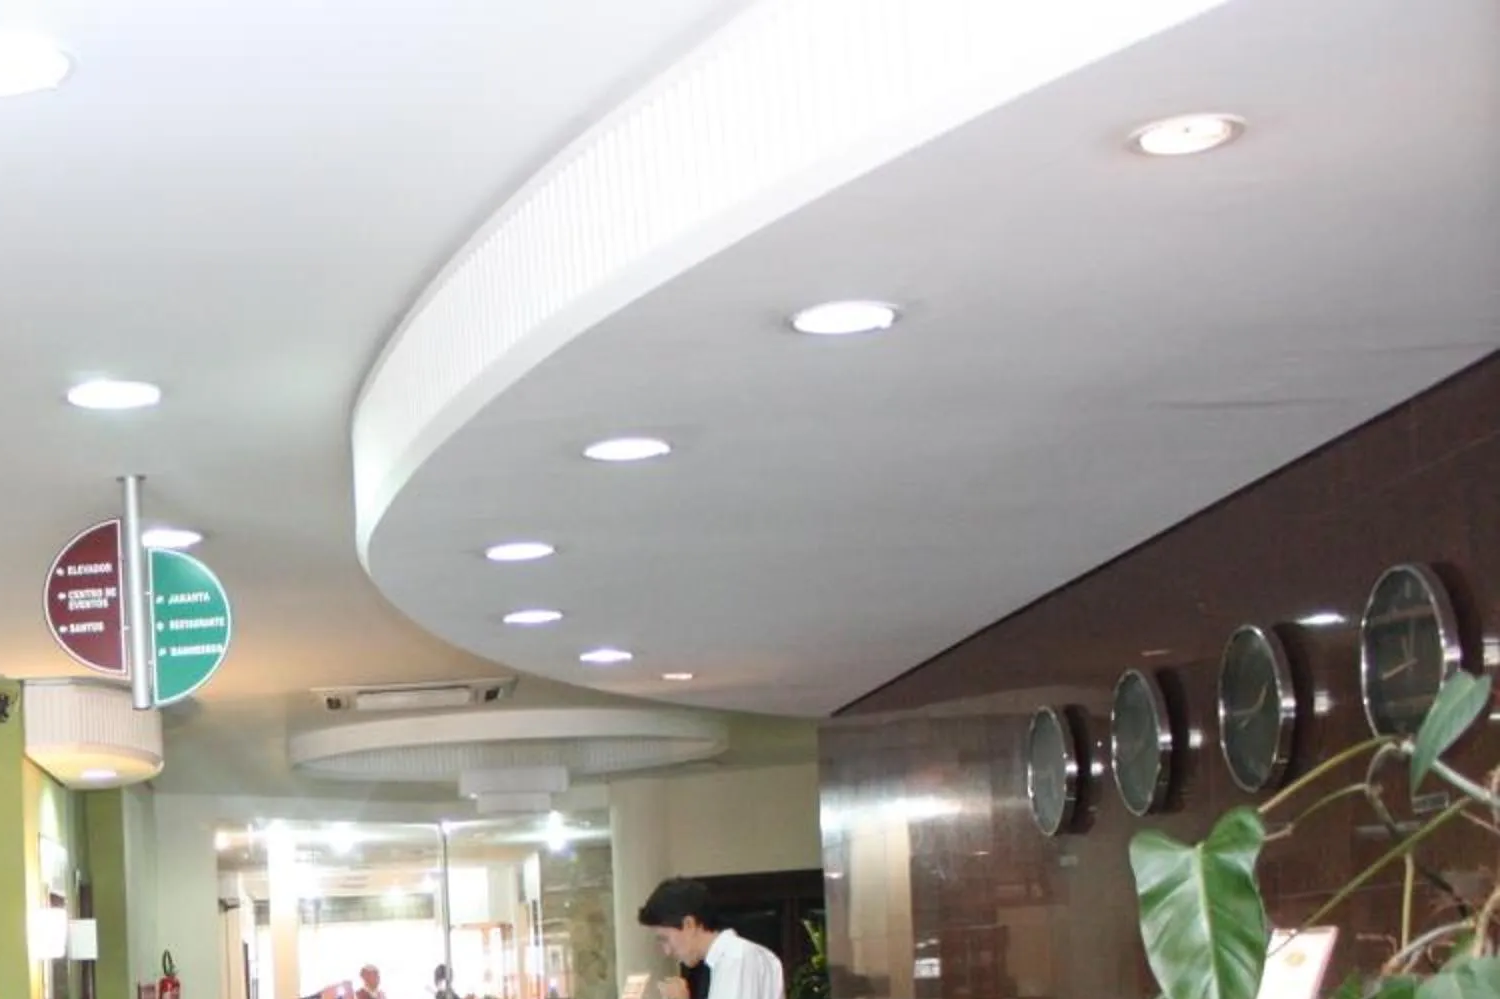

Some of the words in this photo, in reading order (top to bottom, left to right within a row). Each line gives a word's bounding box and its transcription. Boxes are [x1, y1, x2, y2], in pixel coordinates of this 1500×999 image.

[67, 563, 112, 575] ELEVADOR
[67, 588, 102, 599] CENTRO
[105, 587, 117, 597] DE
[67, 599, 108, 610] EVENTOS
[69, 621, 104, 633] SANTOS
[169, 617, 225, 631] RESTAURANTE
